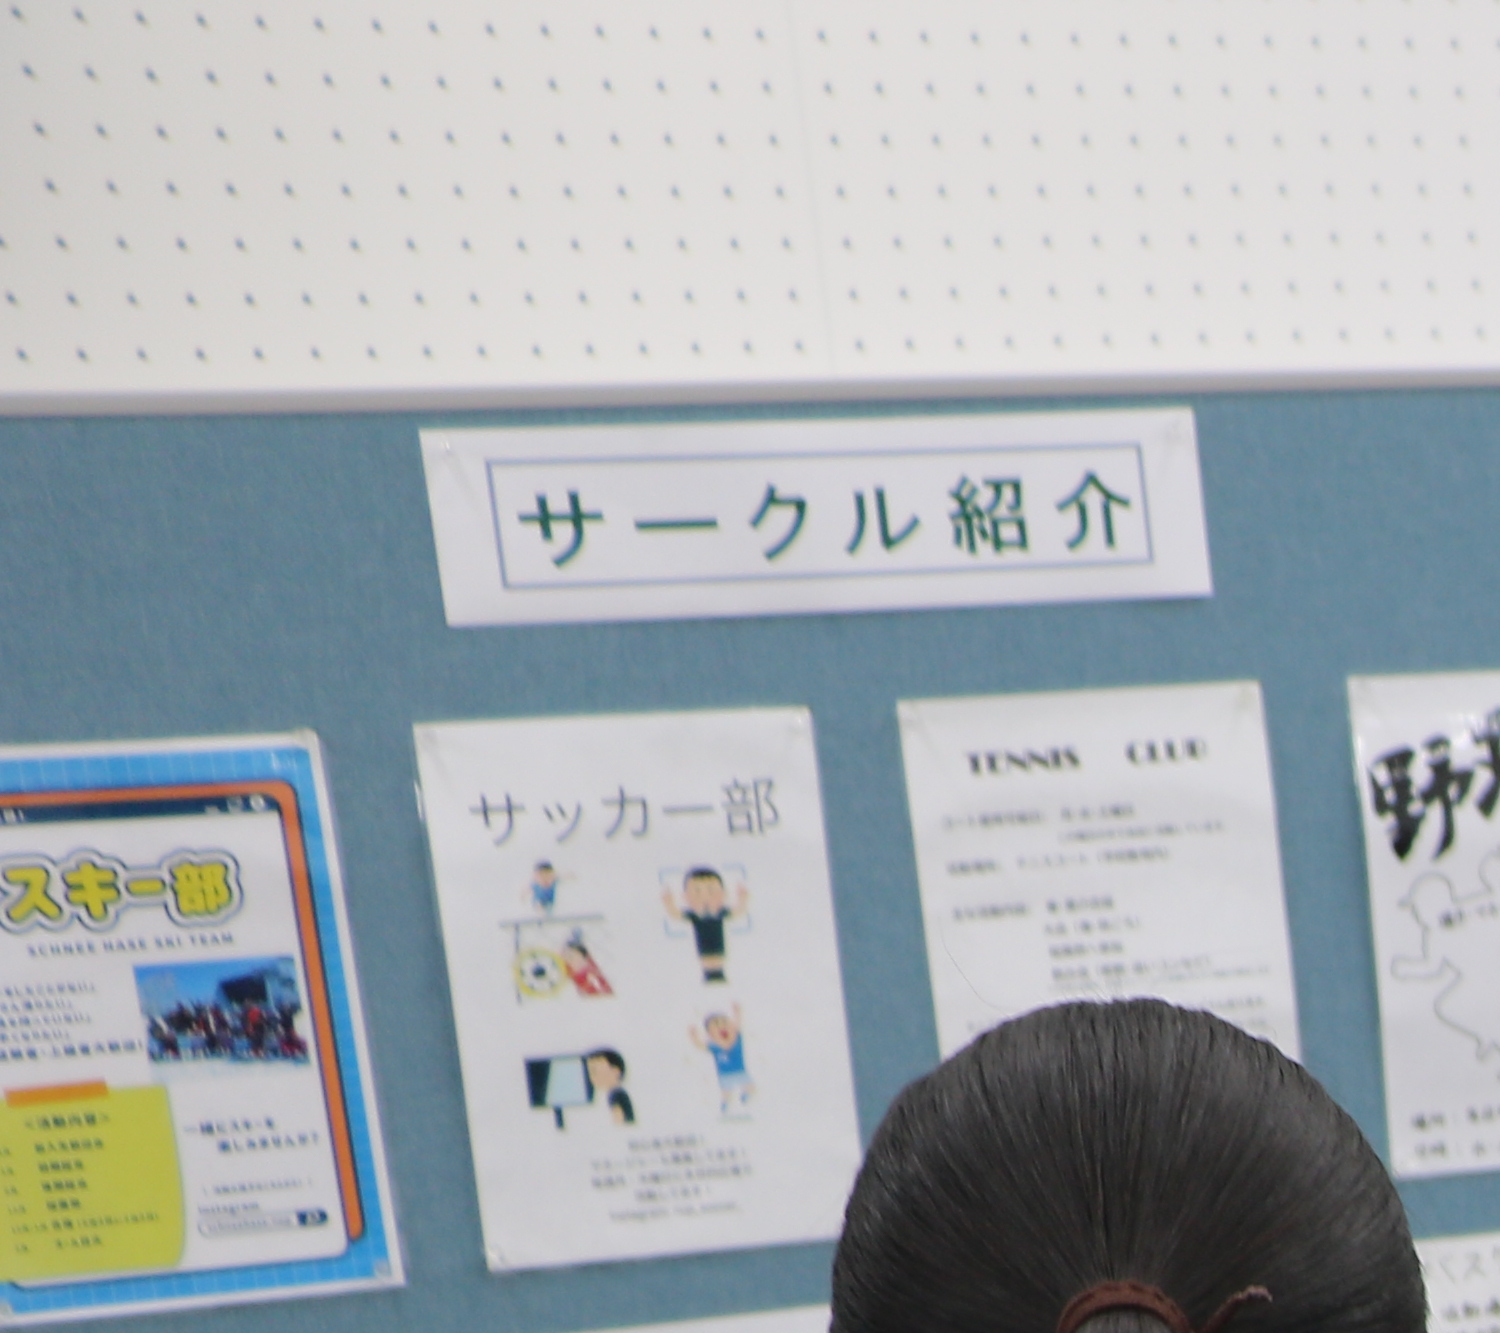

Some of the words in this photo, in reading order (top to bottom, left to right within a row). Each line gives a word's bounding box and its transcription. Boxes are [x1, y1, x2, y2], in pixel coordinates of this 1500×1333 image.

[516, 470, 1134, 567] サークル紹介
[966, 745, 1080, 776] TENNIS
[470, 776, 782, 846] サッカー部
[3, 859, 233, 923] スキー部
[28, 941, 97, 958] SCHNEE
[155, 936, 182, 950] SKI
[189, 933, 235, 947] TEAM
